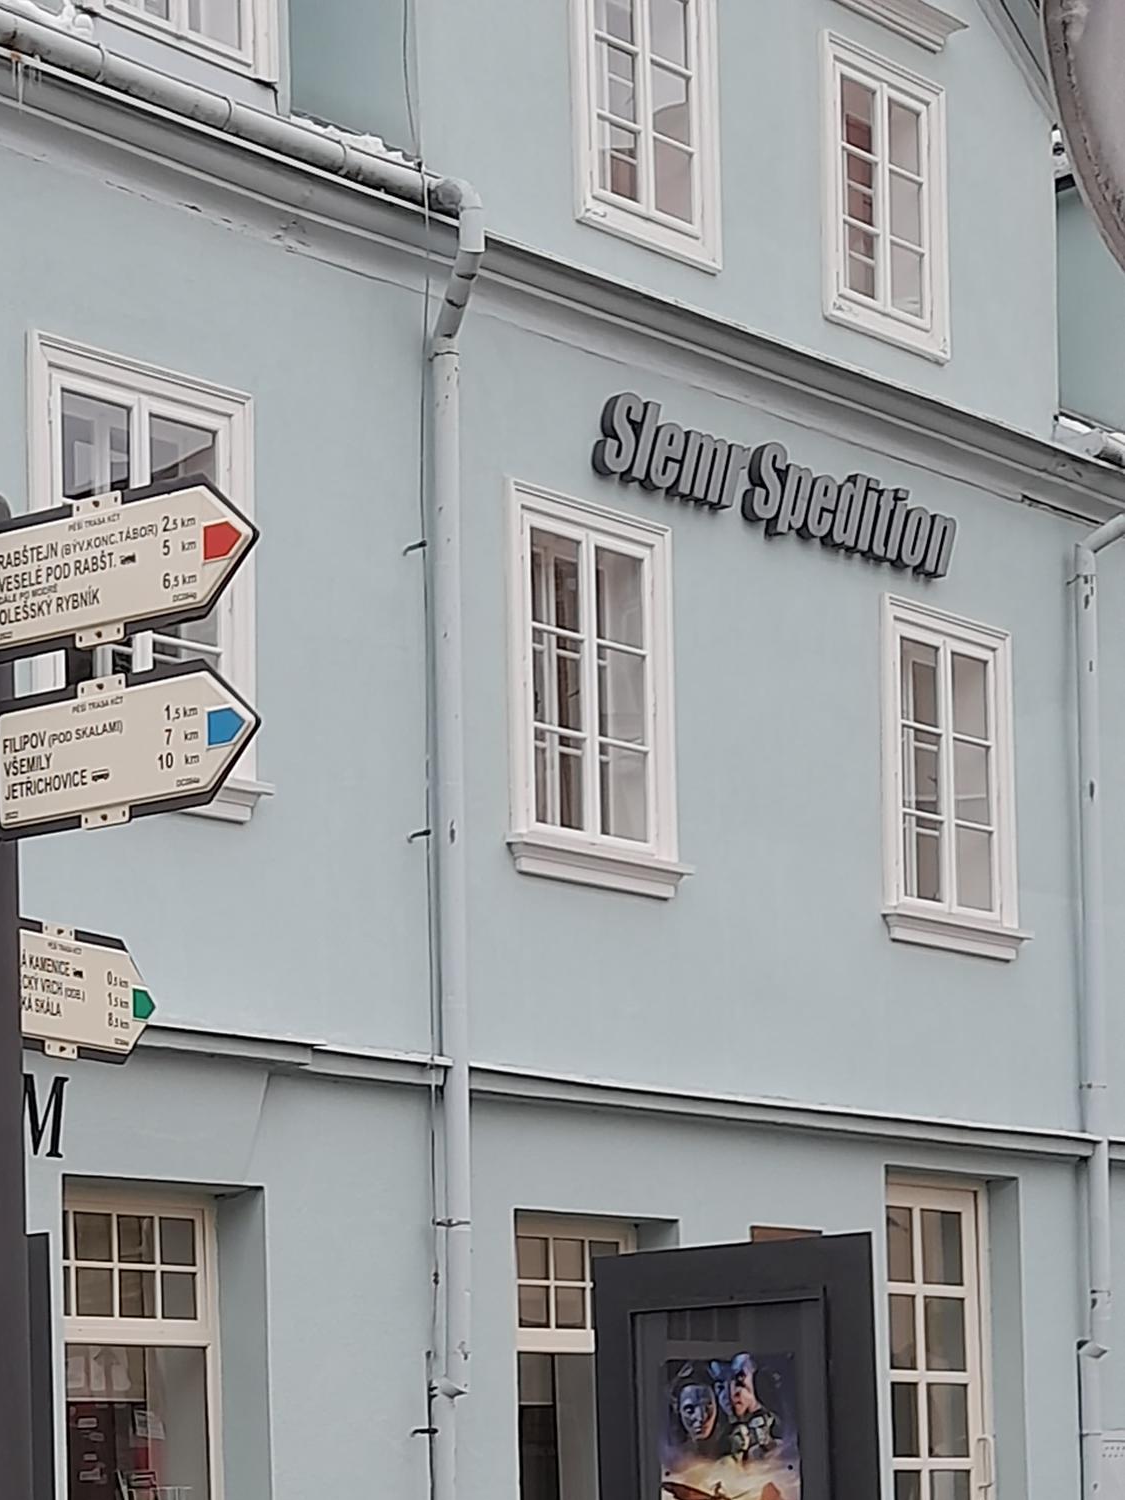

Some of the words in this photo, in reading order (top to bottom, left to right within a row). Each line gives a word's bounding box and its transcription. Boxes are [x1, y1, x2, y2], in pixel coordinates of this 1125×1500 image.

[592, 392, 751, 510] Slemr
[741, 442, 957, 580] Spedition
[162, 515, 178, 532] 2,5
[180, 517, 196, 528] km
[46, 563, 71, 583] POD
[74, 550, 117, 577] RABŠT.
[162, 539, 171, 556] 5
[181, 541, 196, 552] km
[56, 586, 100, 613] RYBNÍK
[162, 572, 179, 589] 6,5
[181, 574, 197, 585] km
[3, 731, 46, 754] FILIPOV
[48, 730, 72, 748] (POD
[75, 720, 123, 741] SKALAMI)
[164, 705, 180, 721] 1,5
[183, 707, 198, 718] km
[3, 753, 52, 777] VŠEMILY
[164, 729, 172, 745] 7
[184, 731, 199, 741] km
[5, 769, 87, 800] JETŘICHOVICE
[158, 753, 173, 770] 10
[185, 755, 199, 765] km
[119, 977, 129, 988] km
[120, 998, 129, 1009] km
[120, 1018, 129, 1029] km
